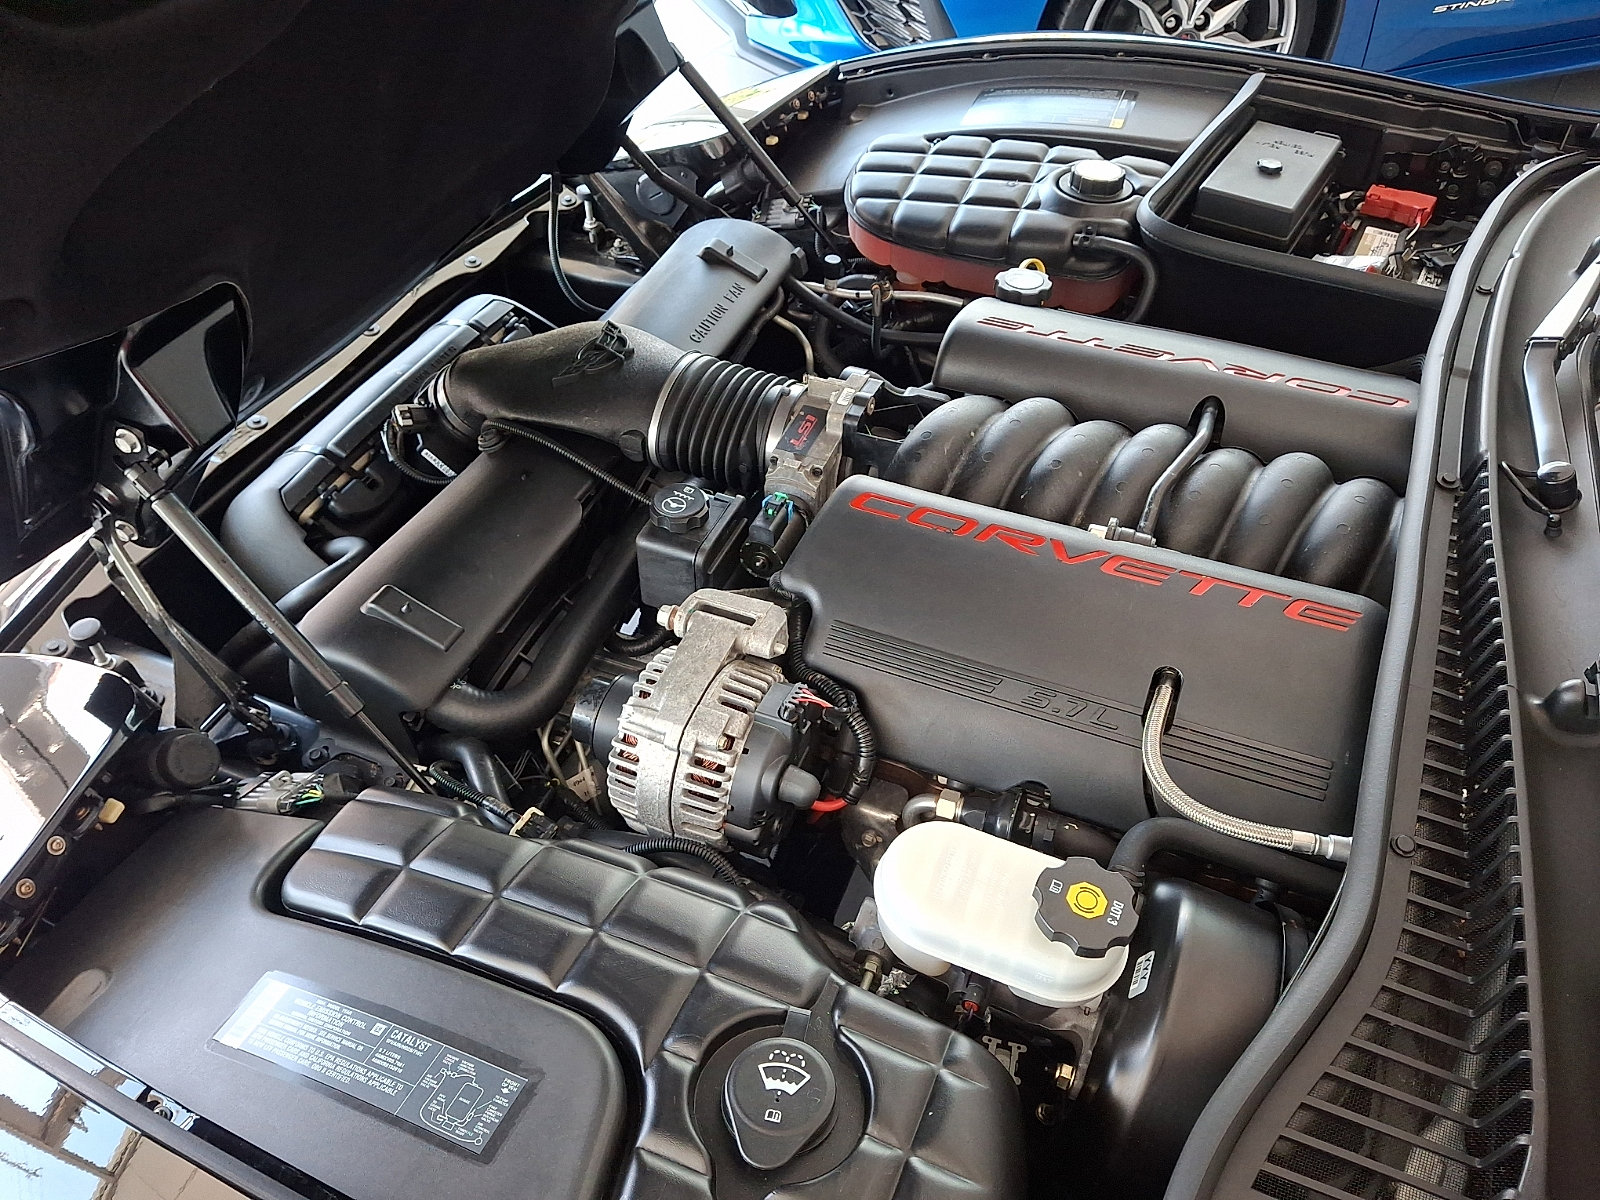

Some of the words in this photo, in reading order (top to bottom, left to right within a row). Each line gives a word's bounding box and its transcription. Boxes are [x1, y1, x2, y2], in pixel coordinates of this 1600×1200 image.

[1432, 0, 1511, 13] STING
[690, 303, 728, 343] CAUTION
[723, 282, 745, 303] FAN
[977, 316, 1410, 407] CORVETTE
[848, 491, 1364, 632] CORVETTE
[1026, 679, 1120, 731] 5.7L
[1110, 900, 1124, 920] DOT
[1107, 918, 1118, 926] 3
[341, 1015, 366, 1030] CONTROL
[390, 1030, 432, 1052] CATALYST
[334, 1057, 368, 1074] REGULATIONS
[366, 1070, 396, 1087] APPLICABLE
[396, 1082, 404, 1090] TO
[367, 1080, 398, 1096] APPLICABLE
